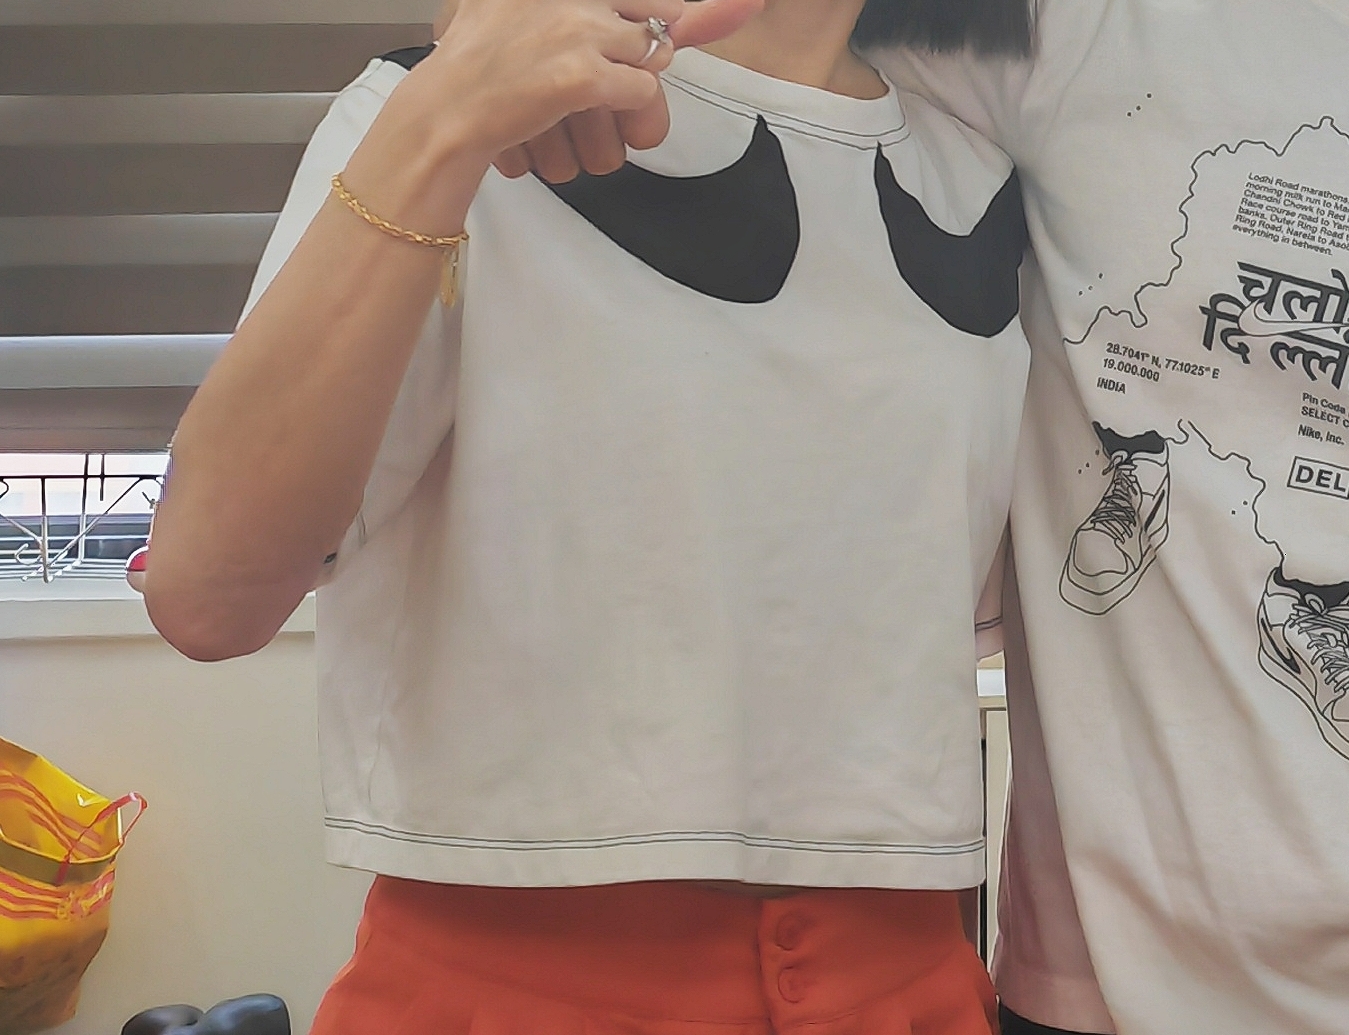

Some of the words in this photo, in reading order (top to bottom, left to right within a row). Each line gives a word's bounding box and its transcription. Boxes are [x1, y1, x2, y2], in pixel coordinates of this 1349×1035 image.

[1246, 182, 1282, 196] morning
[1285, 190, 1303, 201] milk
[1306, 197, 1320, 205] run
[1323, 200, 1332, 208] to
[1249, 172, 1273, 185] Lodhi
[1275, 178, 1299, 190] Road
[1301, 185, 1349, 203] marathons.
[1241, 198, 1263, 209] Race
[1266, 205, 1296, 217] course
[1298, 212, 1318, 223] road
[1321, 218, 1329, 226] to
[1244, 189, 1281, 204] Chandni
[1283, 198, 1314, 212] Chowk
[1317, 207, 1325, 215] to
[1327, 210, 1345, 221] Red
[1232, 224, 1279, 242] everything
[1281, 235, 1289, 244] in
[1236, 214, 1256, 227] Ring
[1286, 227, 1315, 241] Narela
[1318, 235, 1326, 243] to
[1270, 214, 1295, 226] Outer
[1298, 221, 1317, 234] Ring
[1320, 227, 1343, 239] Road
[1097, 377, 1125, 394] INDIA
[1212, 368, 1220, 379] E
[1303, 393, 1318, 405] Pin
[1301, 406, 1340, 424] SELECT
[1298, 424, 1323, 442] Nike,
[1326, 432, 1344, 445] Inc.
[1295, 465, 1346, 492] DEL
